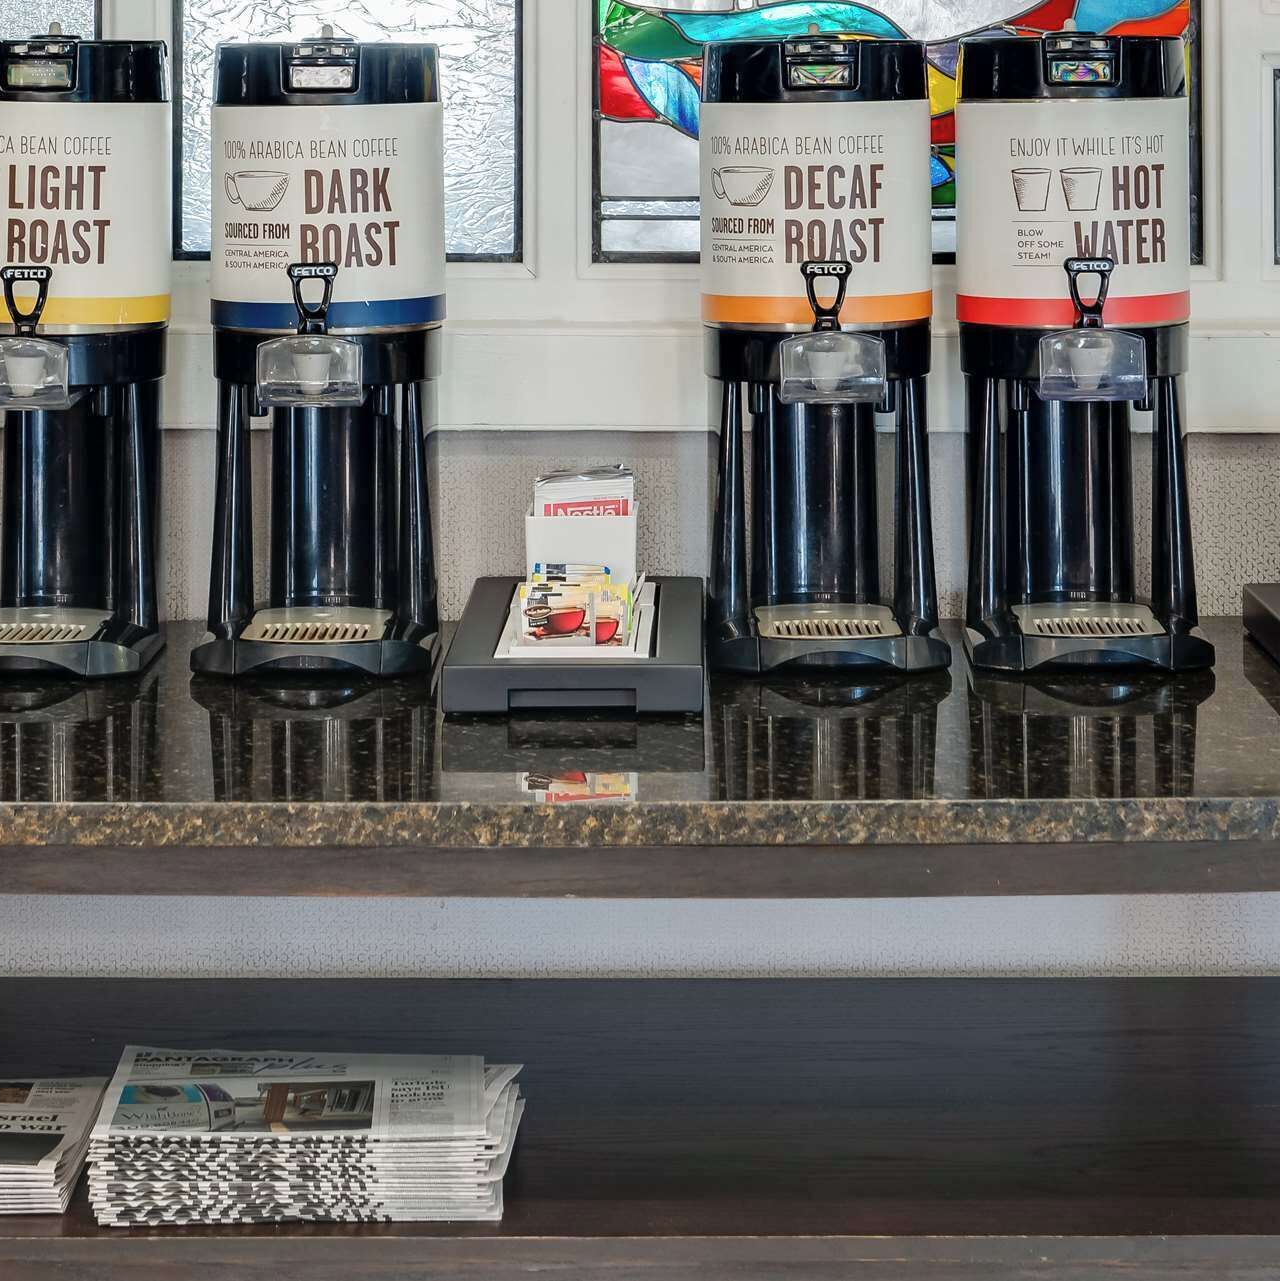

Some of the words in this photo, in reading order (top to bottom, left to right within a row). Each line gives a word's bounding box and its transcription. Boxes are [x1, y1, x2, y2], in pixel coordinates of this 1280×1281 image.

[20, 135, 57, 155] BEAN
[64, 136, 112, 155] COFFEE
[224, 140, 246, 160] 100%
[249, 140, 304, 160] ARABICA
[310, 139, 347, 159] BEAN
[353, 137, 398, 158] COFFEE
[711, 136, 731, 155] 100%
[734, 136, 789, 155] ARABICA
[795, 136, 832, 155] BEAN
[838, 135, 884, 154] COFFEE
[1010, 137, 1051, 157] ENJOY
[1057, 137, 1068, 156] IT
[1072, 136, 1116, 156] WHILE
[1122, 135, 1142, 155] IT'S
[1146, 134, 1165, 154] HOT
[8, 164, 106, 210] LIGHT
[304, 167, 392, 214] DARK
[784, 164, 884, 210] DECAF
[1112, 164, 1165, 211] HOT
[224, 222, 259, 239] SOURCED
[263, 223, 290, 239] FROM
[711, 217, 744, 234] SOURCED
[747, 218, 774, 234] FROM
[1017, 229, 1044, 237] BLOW
[7, 218, 111, 264] ROAST
[300, 220, 400, 268] ROAST
[712, 244, 737, 252] CENTRAL
[738, 244, 774, 252] AMERICA
[785, 218, 885, 264] ROAST
[1017, 240, 1035, 248] OFF
[1037, 240, 1064, 248] SOME
[1074, 218, 1166, 265] WATER
[225, 249, 252, 258] CENTRAL
[253, 250, 289, 258] AMERICA
[716, 255, 737, 263] SOUTH
[738, 256, 774, 264] AMERICA
[1017, 252, 1051, 260] STEAM!
[7, 269, 47, 278] FETCO
[230, 261, 252, 269] SOUTH
[252, 261, 289, 270] AMERICA
[293, 267, 333, 276] FETCO
[807, 265, 847, 274] FETCO
[1073, 262, 1110, 270] FETCO
[134, 1056, 295, 1064] PANTAGRAPH
